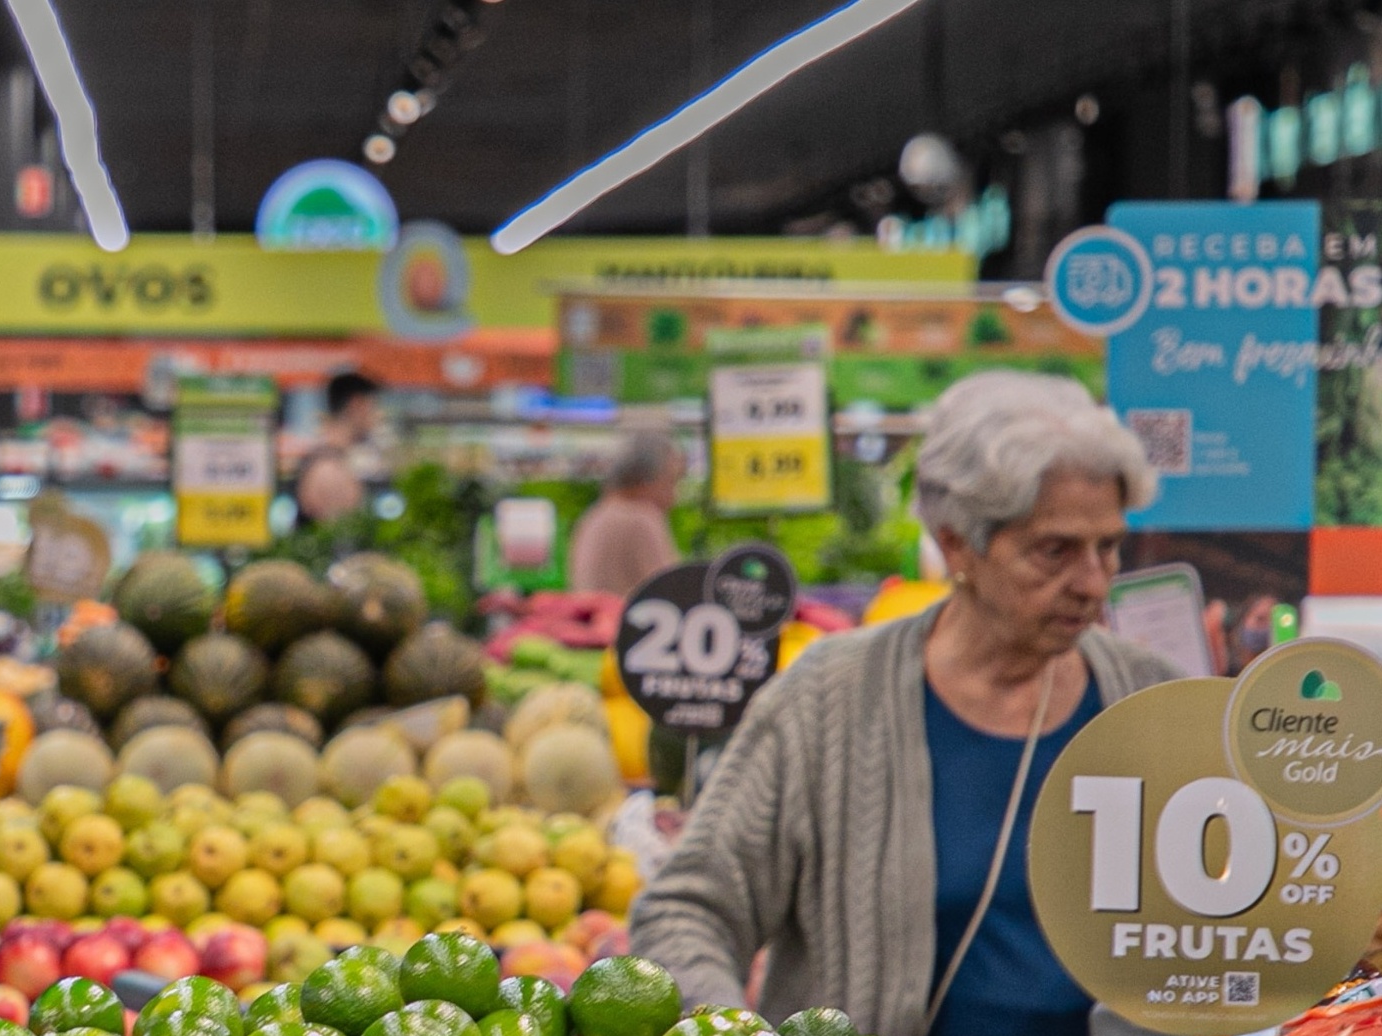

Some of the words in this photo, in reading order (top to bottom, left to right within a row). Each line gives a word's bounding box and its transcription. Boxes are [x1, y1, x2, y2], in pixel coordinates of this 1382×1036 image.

[1153, 232, 1307, 260] RECEBA
[1324, 231, 1378, 260] EM
[38, 262, 215, 312] OVOS
[1154, 266, 1187, 309] 2
[1194, 265, 1382, 308] HORAS
[1251, 707, 1339, 734] Cliente
[1256, 733, 1382, 761] mais
[1283, 761, 1339, 783] Gold
[1279, 883, 1335, 905] OFF
[1111, 923, 1314, 963] FRUTAS
[1165, 974, 1220, 988] ATIVE
[1146, 989, 1176, 1003] NO
[1181, 991, 1220, 1004] APP
